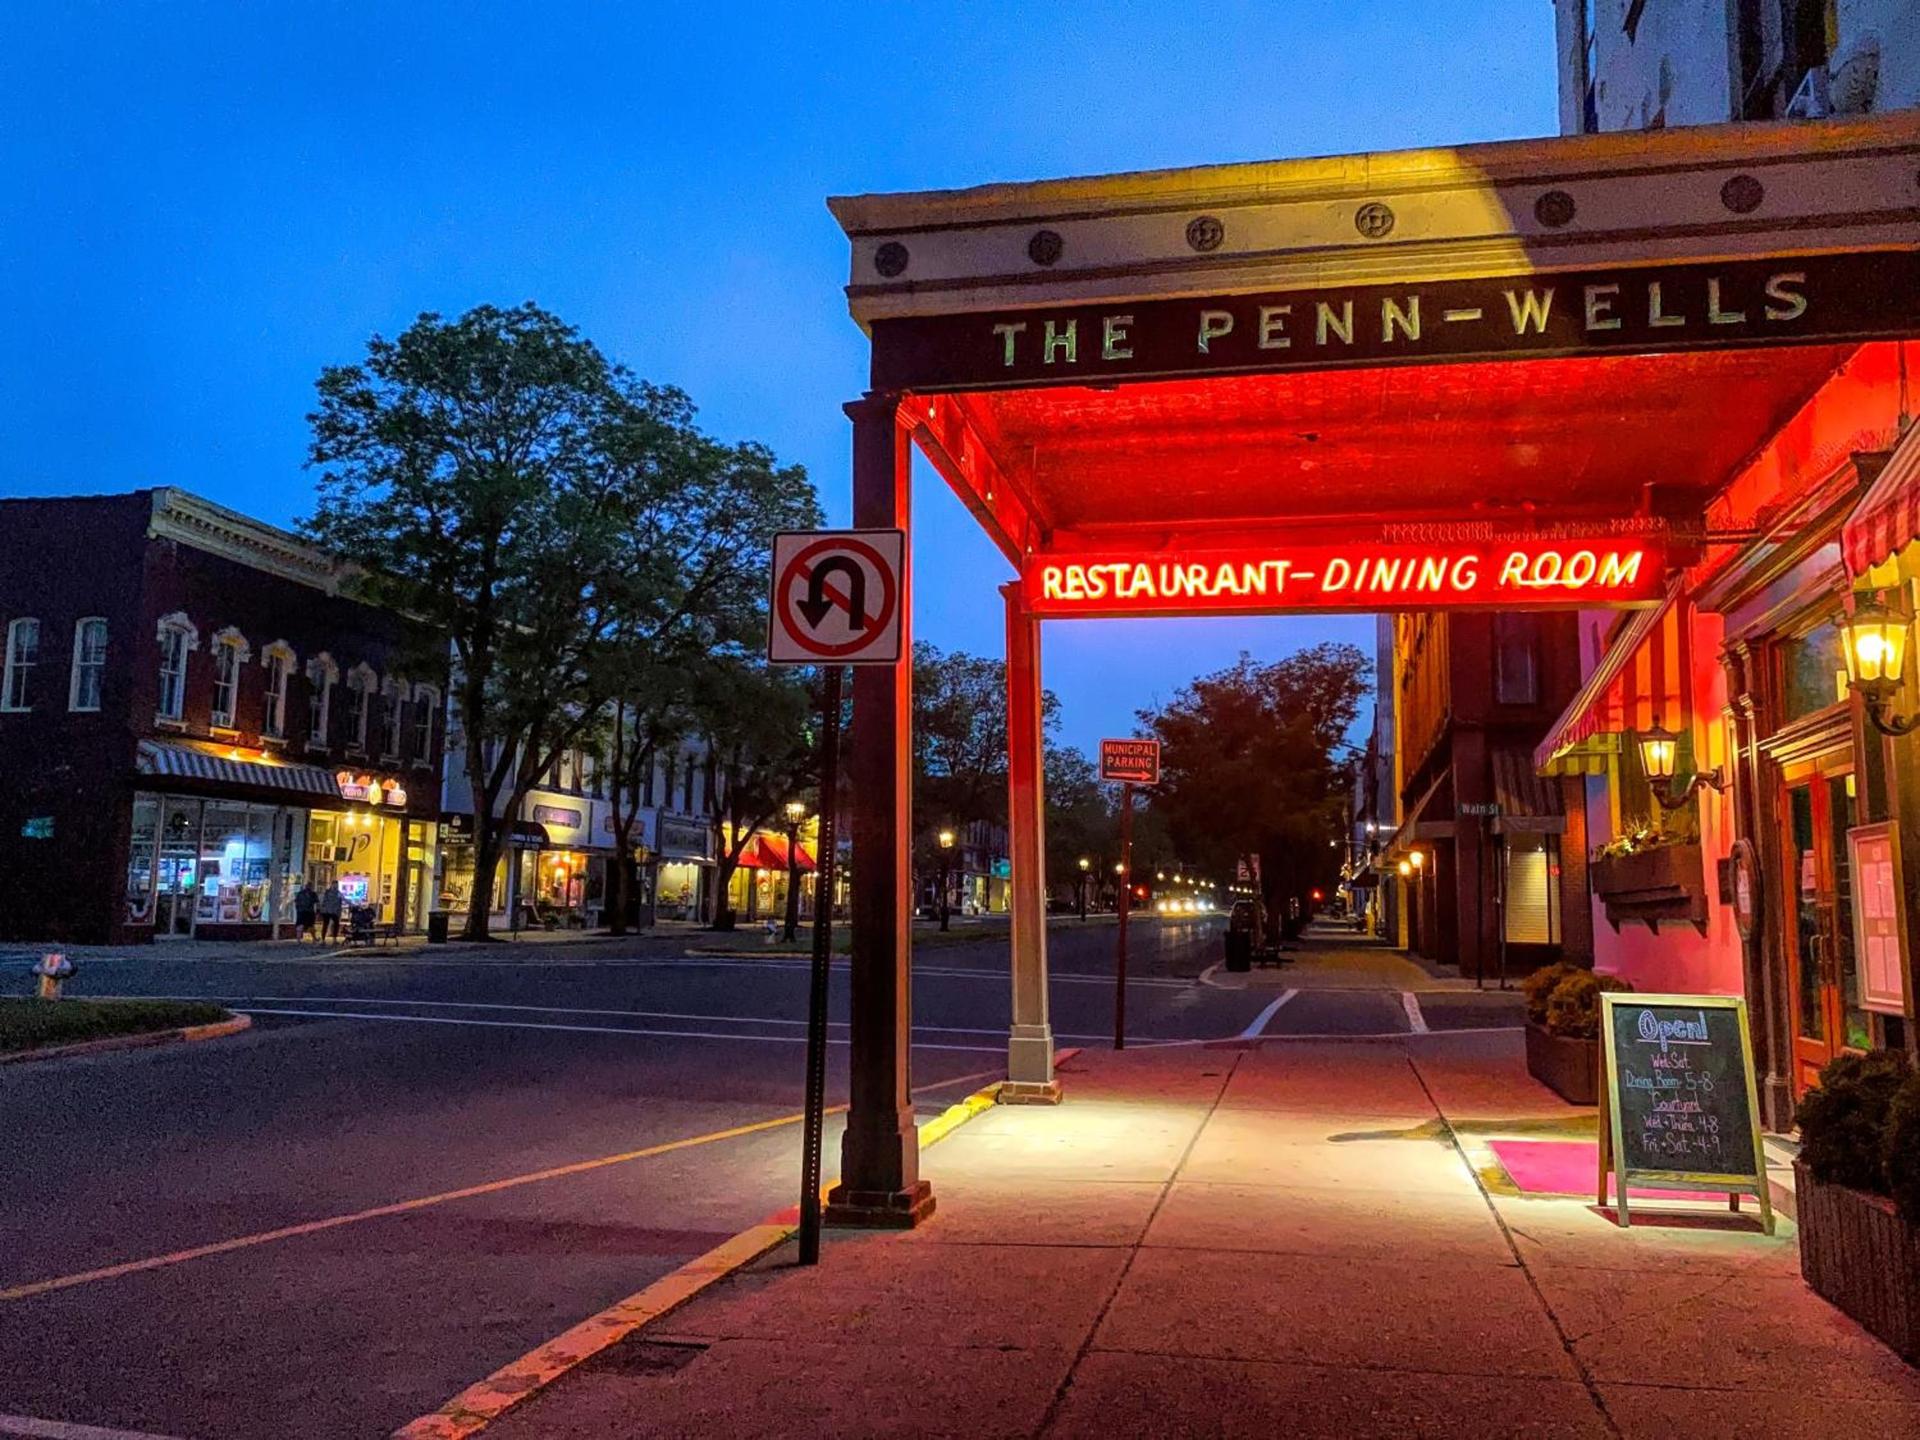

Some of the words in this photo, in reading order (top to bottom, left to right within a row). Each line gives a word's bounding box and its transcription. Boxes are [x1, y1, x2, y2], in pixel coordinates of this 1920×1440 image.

[992, 315, 1134, 367] THE
[1198, 271, 1808, 354] PENN-WELLS
[1499, 550, 1644, 590] ROOM
[1104, 743, 1155, 756] MUNICIPAL
[1106, 756, 1152, 769] PARKING
[1638, 1009, 1708, 1053] Open!
[1625, 1069, 1654, 1095] Dining
[1652, 1089, 1702, 1120] Courtyard
